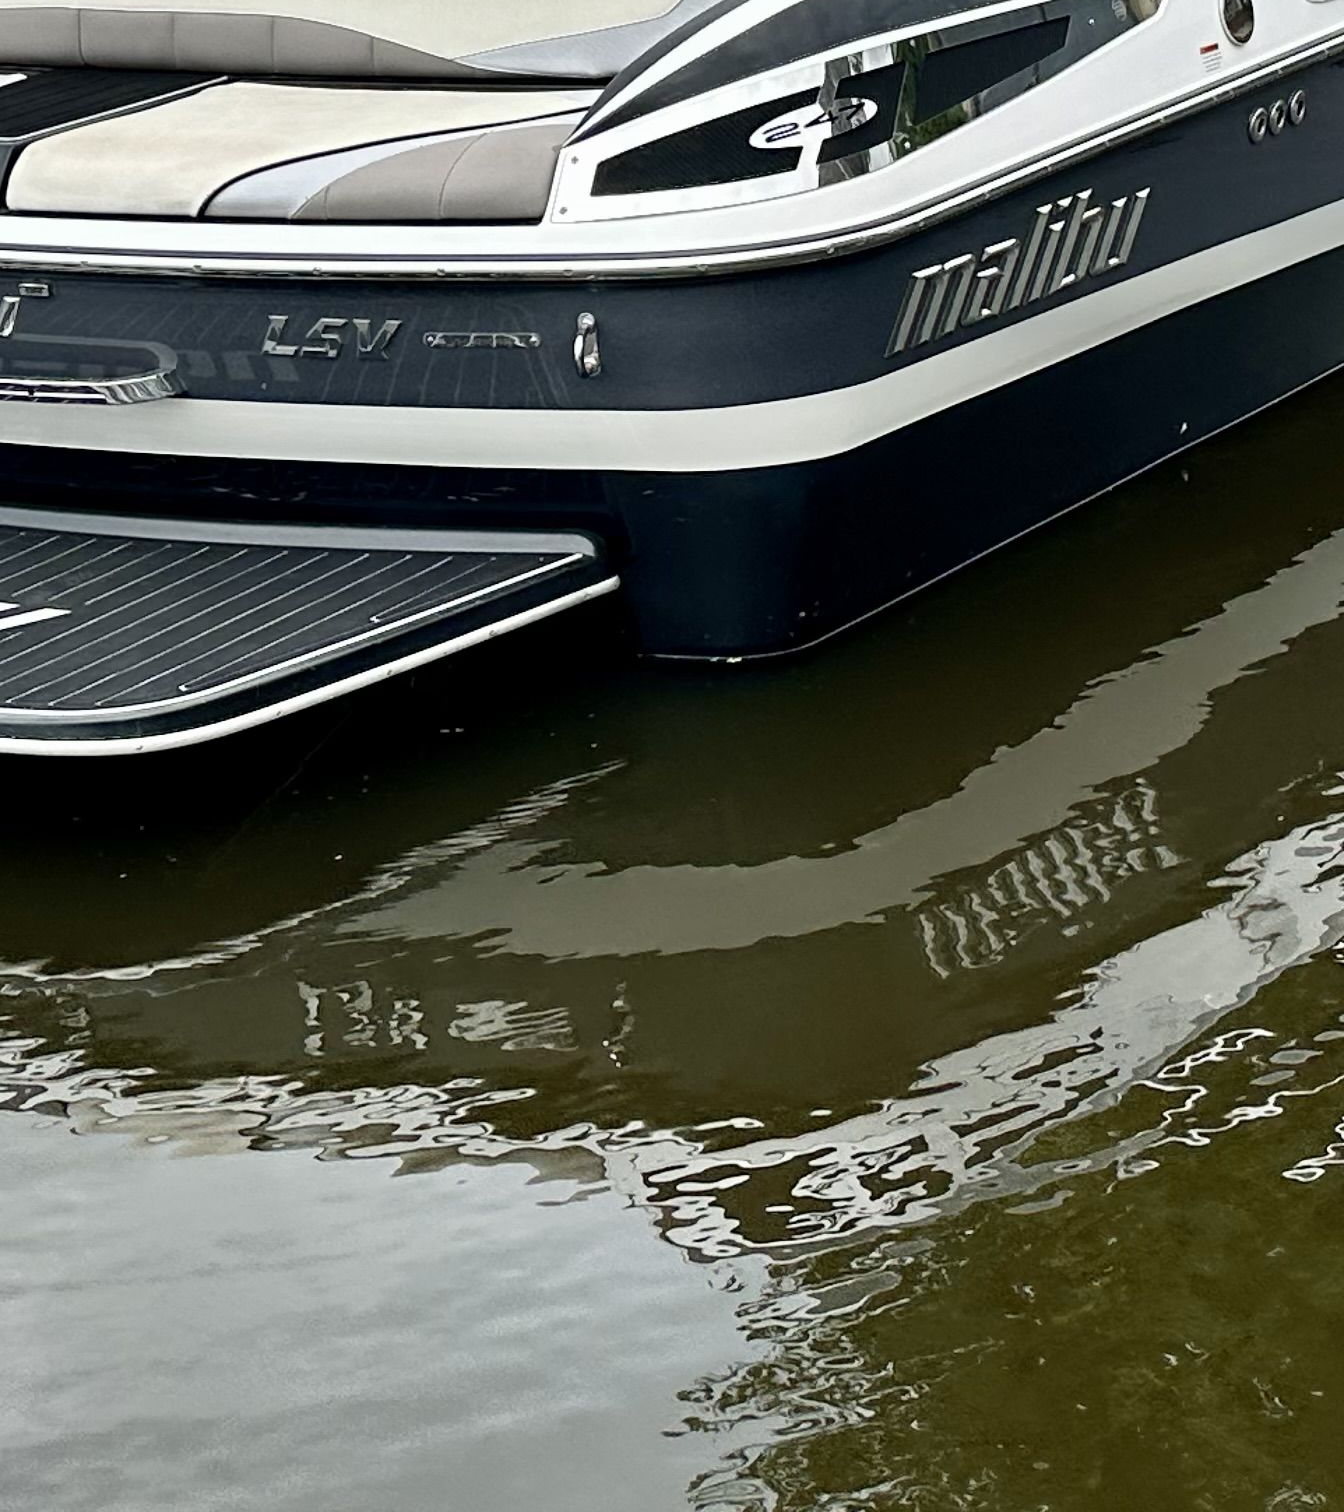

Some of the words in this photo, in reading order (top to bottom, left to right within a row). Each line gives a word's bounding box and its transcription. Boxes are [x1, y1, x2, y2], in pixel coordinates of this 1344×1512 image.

[761, 101, 866, 144] 247
[883, 187, 1151, 359] malibu
[261, 314, 403, 359] LSV
